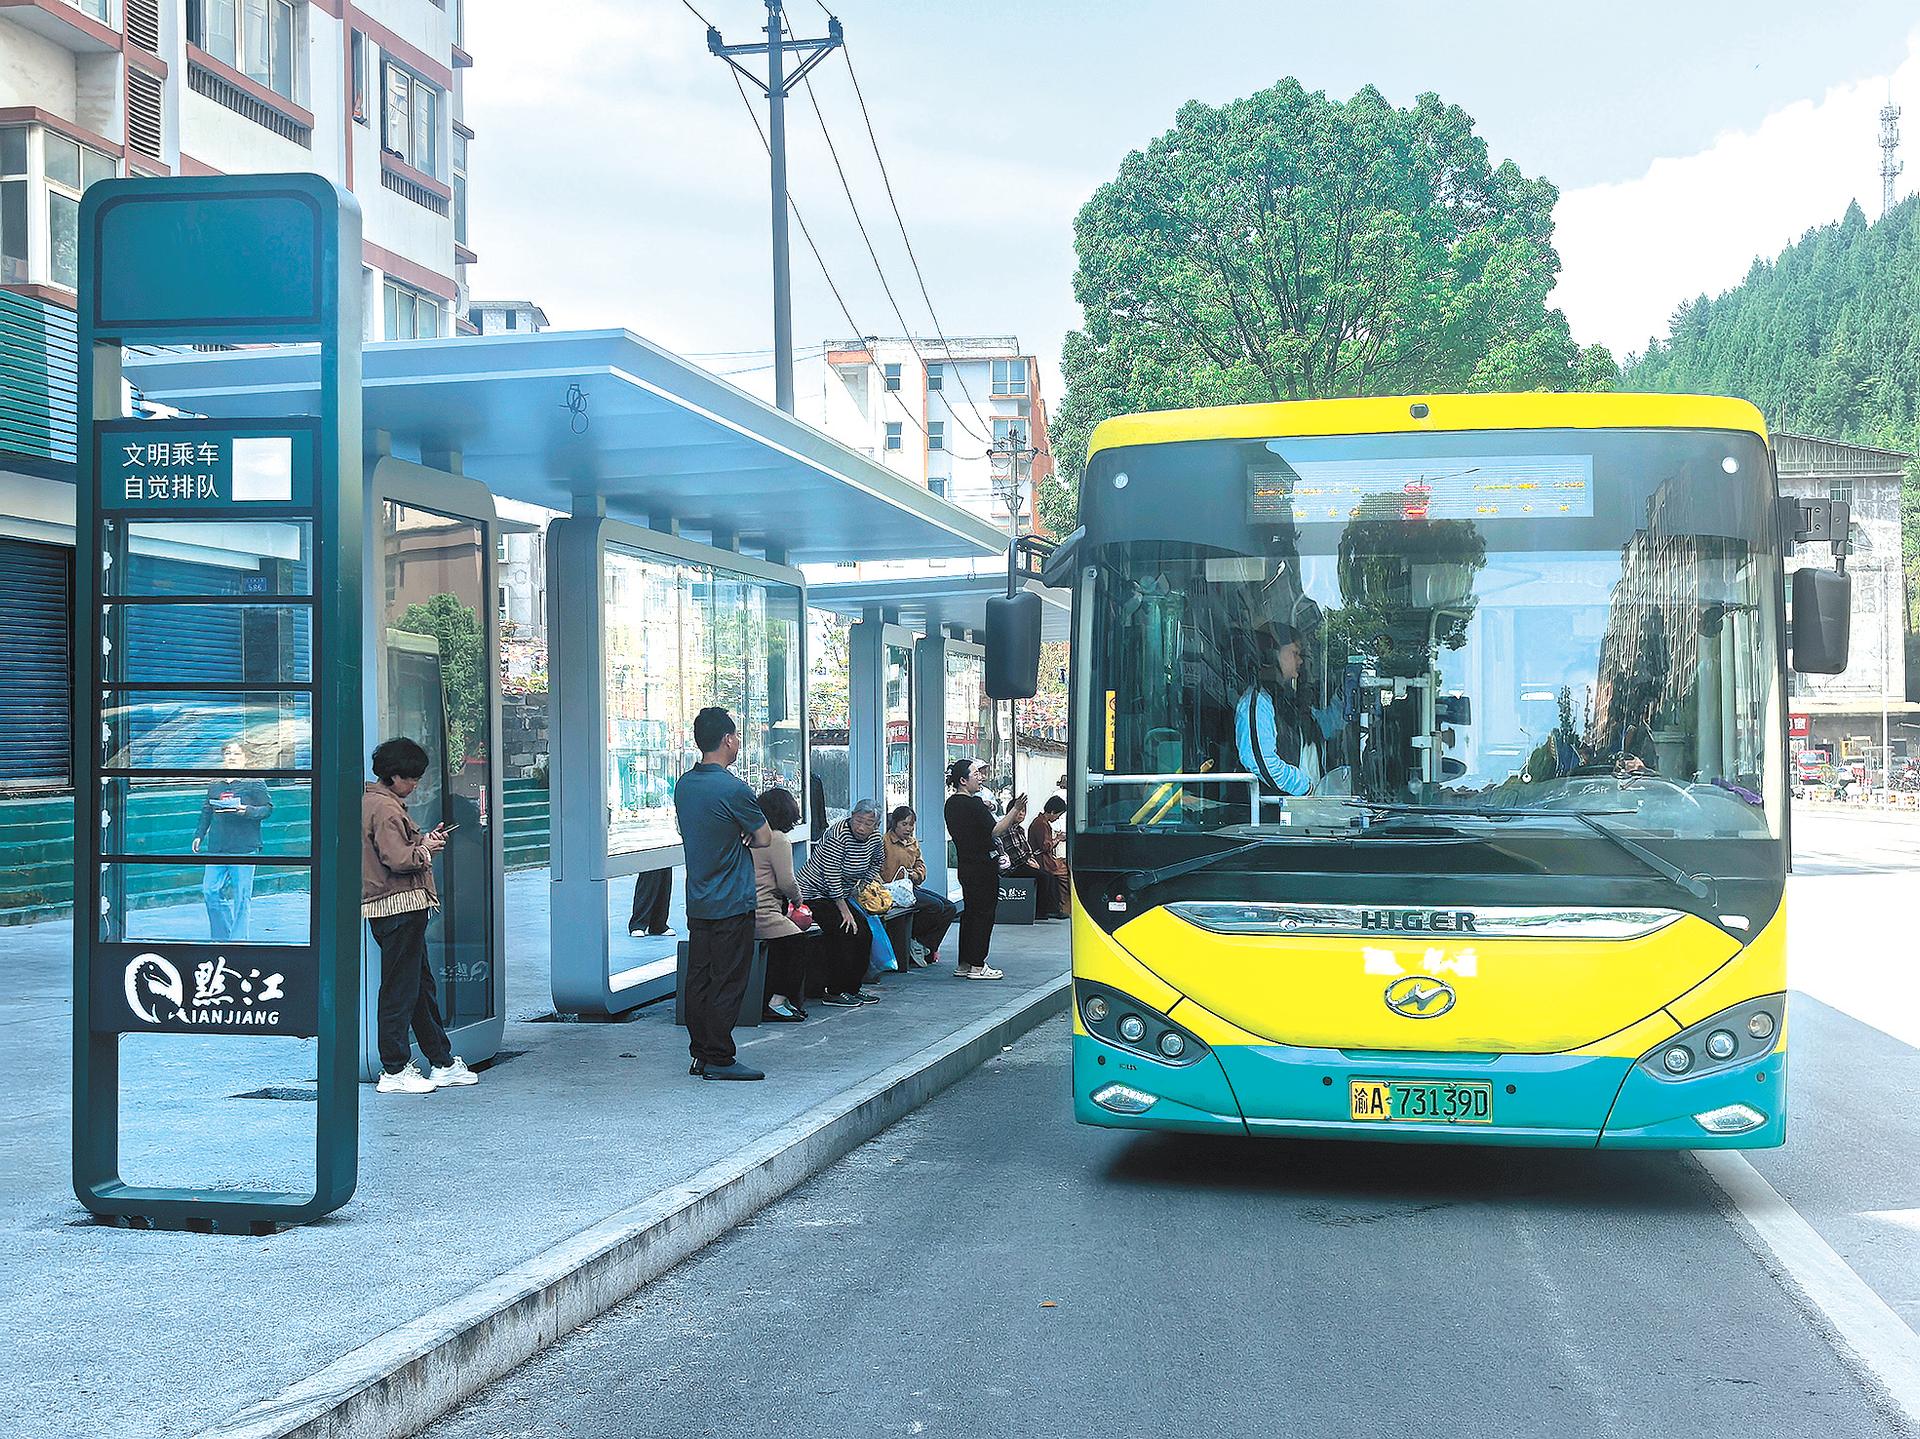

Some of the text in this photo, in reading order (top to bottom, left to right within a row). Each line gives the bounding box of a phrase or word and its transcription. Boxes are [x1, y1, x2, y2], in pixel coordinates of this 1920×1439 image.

[122, 442, 219, 467] 文明乘车
[124, 474, 219, 500] 自觉排队
[1361, 911, 1477, 931] HIGER
